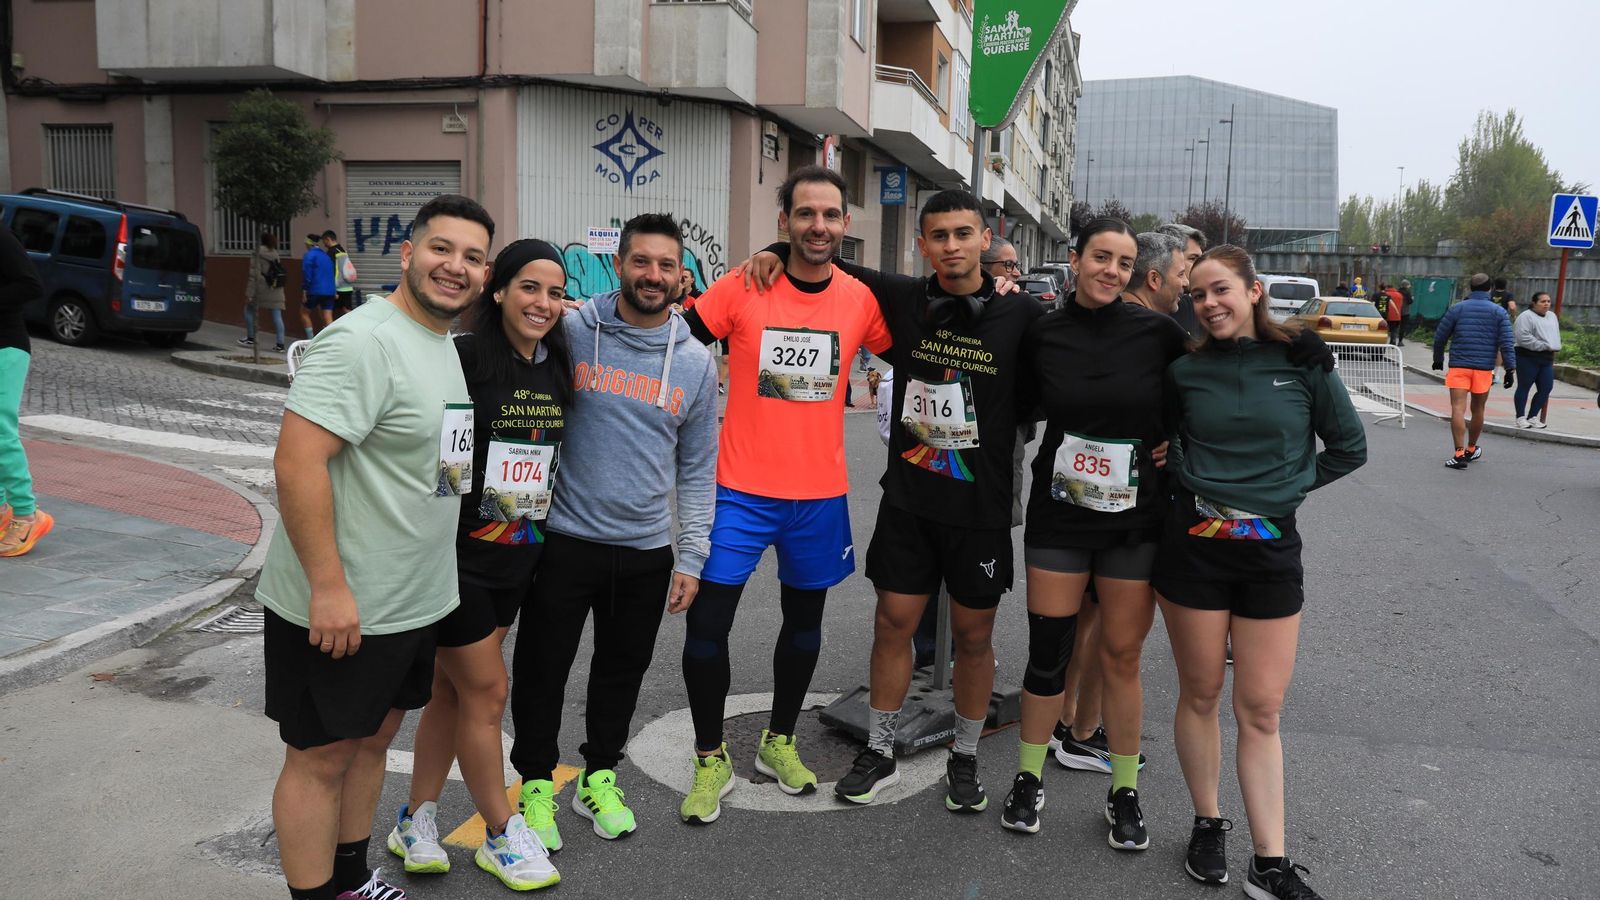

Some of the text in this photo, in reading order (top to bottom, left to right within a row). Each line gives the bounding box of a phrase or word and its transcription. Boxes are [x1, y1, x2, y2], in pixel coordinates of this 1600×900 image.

[985, 24, 1006, 34] SAN
[983, 42, 1030, 55] OURENSE
[783, 335, 800, 343] EMILIO
[952, 334, 982, 346] CARREIRA
[772, 346, 819, 367] 3267
[920, 339, 993, 363] SAN MARTIÑO
[911, 350, 999, 376] CONCELLO DE OURENSE
[501, 404, 562, 417] SAN MARTIÑO
[913, 395, 952, 417] 3116
[491, 419, 535, 429] CONCELLO
[536, 420, 545, 428] DE
[451, 428, 474, 453] 162
[508, 447, 529, 455] SABRINA
[502, 460, 542, 483] 1074
[1073, 452, 1112, 476] 835
